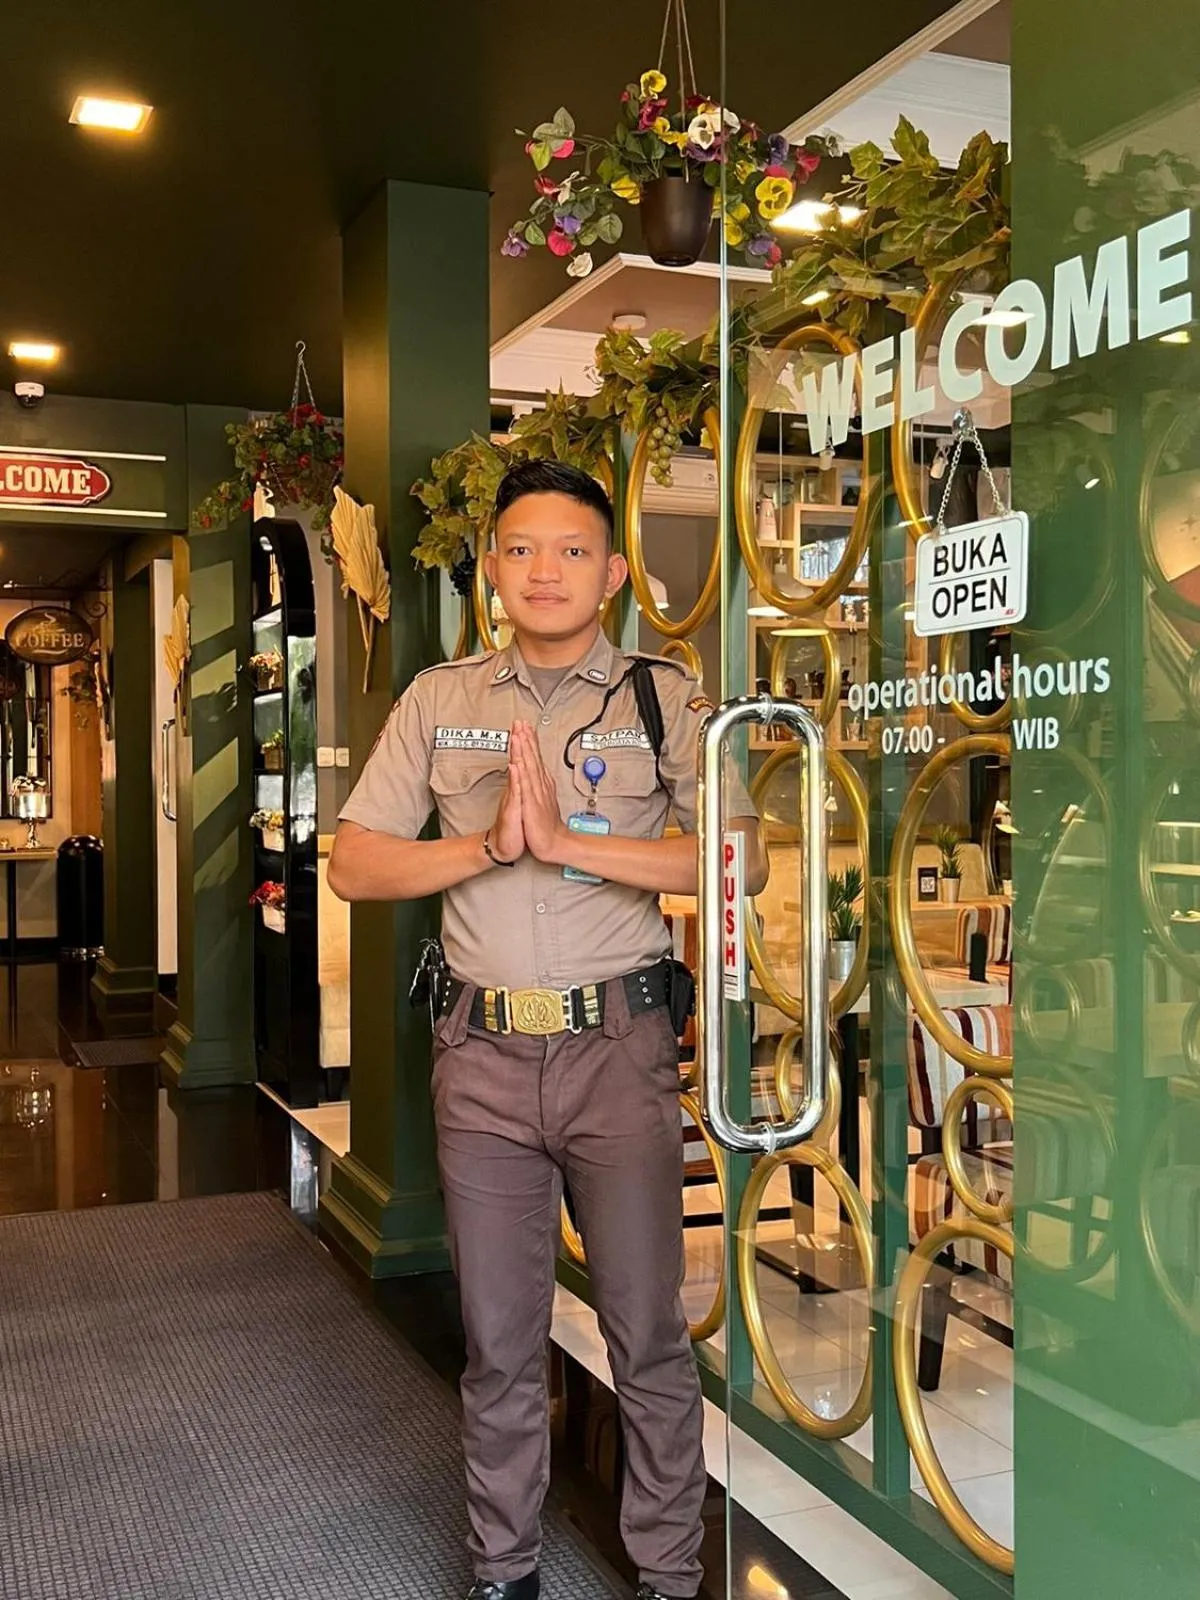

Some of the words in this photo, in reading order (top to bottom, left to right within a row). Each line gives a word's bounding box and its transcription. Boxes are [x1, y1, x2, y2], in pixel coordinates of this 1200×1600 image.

[801, 208, 1194, 455] WELCOME
[0, 464, 91, 495] COME
[933, 532, 1008, 577] BUKA
[932, 575, 1007, 619] OPEN
[15, 631, 84, 648] COFFEE
[848, 655, 1005, 720] operational
[1012, 653, 1111, 699] hours
[441, 729, 474, 738] DIKA
[480, 730, 502, 740] M.K
[881, 725, 934, 755] 07.00
[1013, 717, 1060, 750] WIB
[724, 844, 737, 968] PUSH
